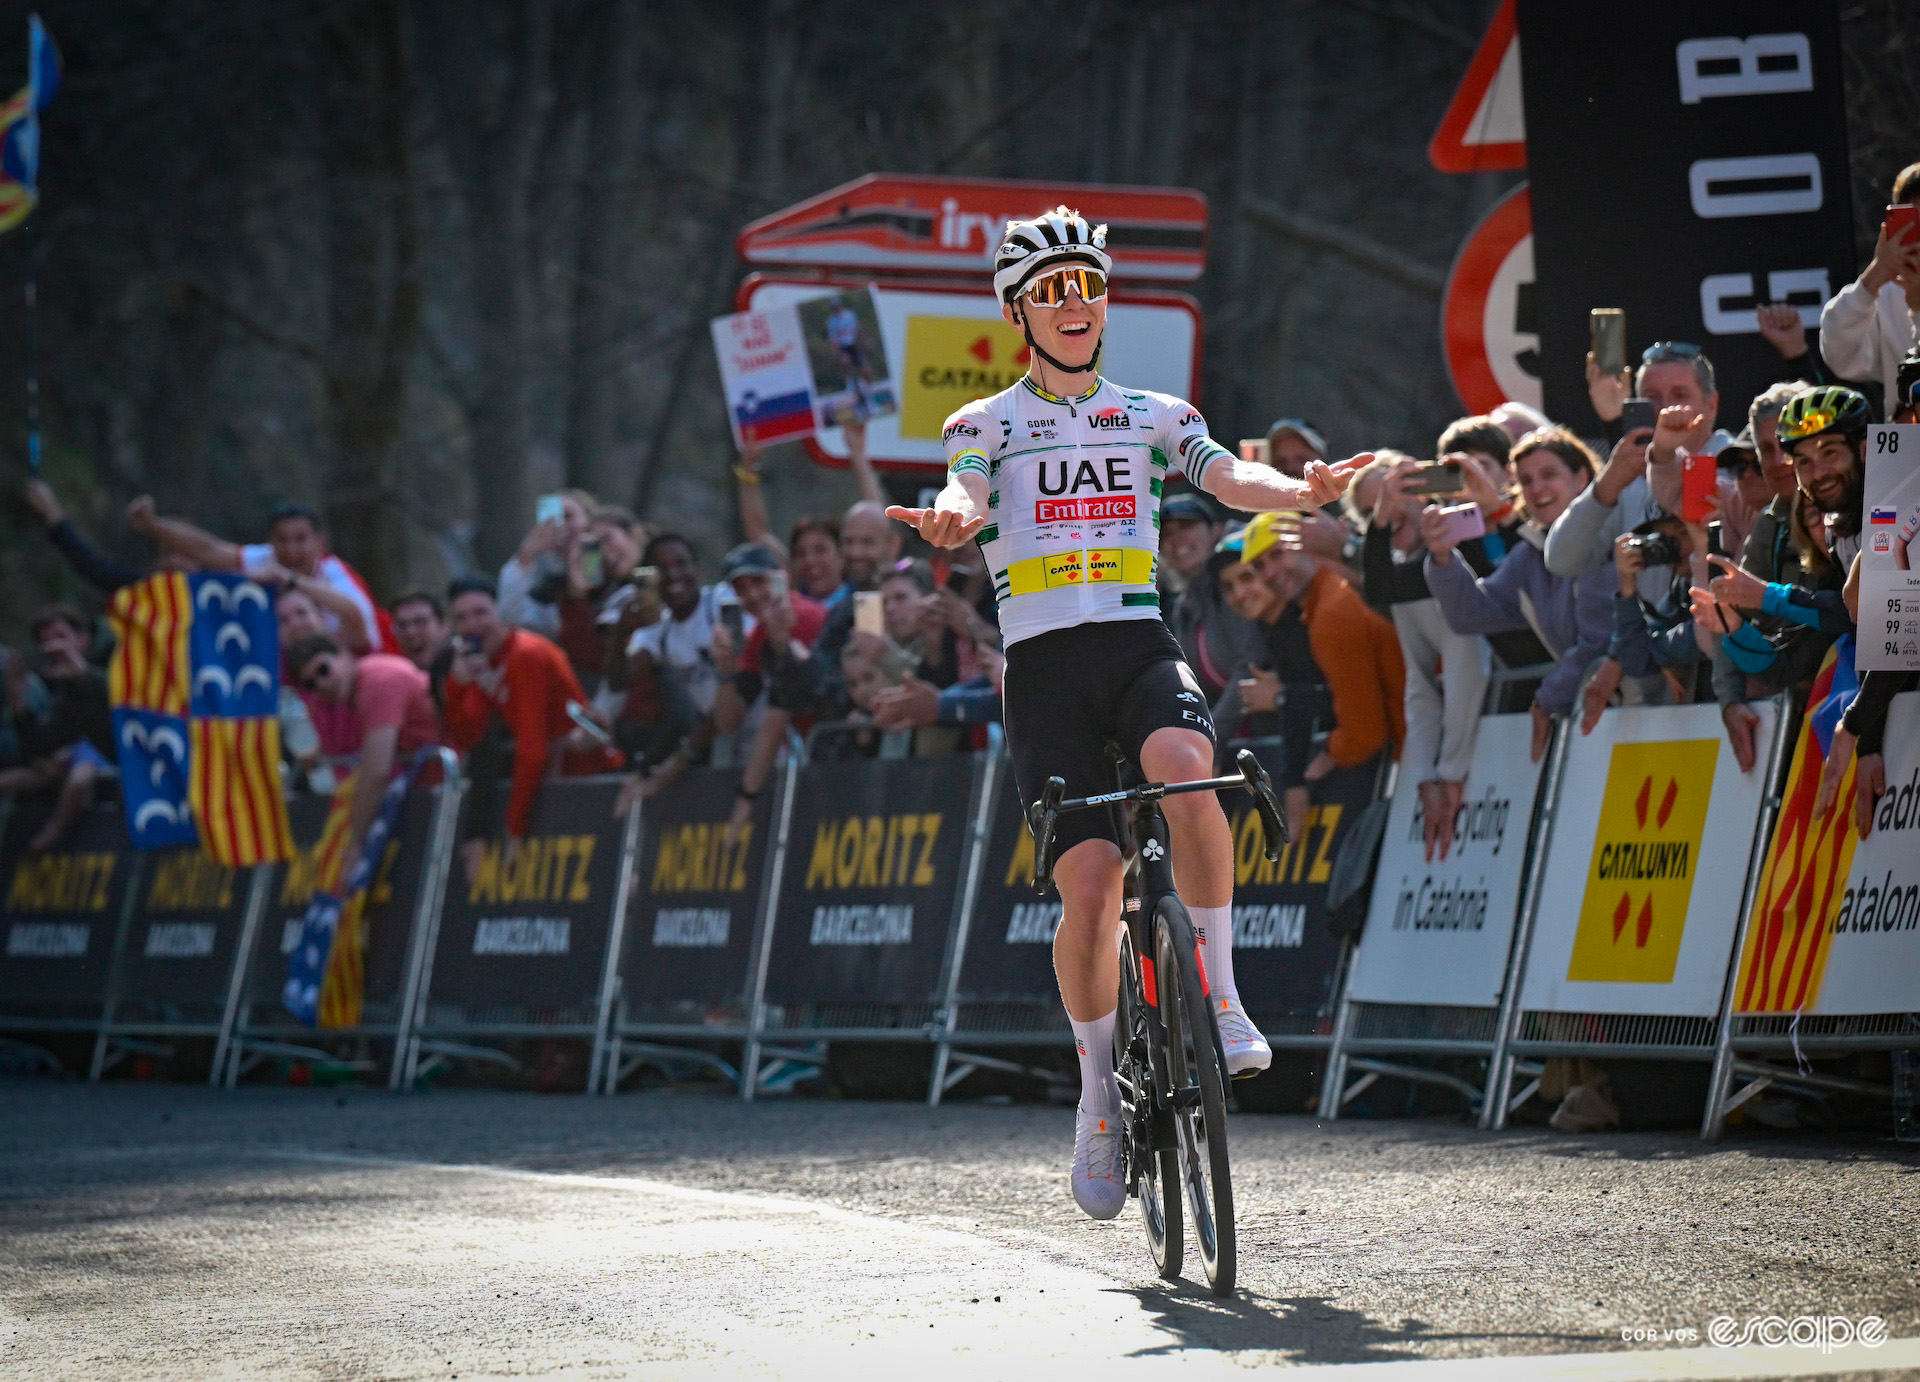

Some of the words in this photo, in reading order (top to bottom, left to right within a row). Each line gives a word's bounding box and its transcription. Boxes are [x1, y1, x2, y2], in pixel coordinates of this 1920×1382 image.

[1027, 418, 1057, 429] GOBIK
[1877, 431, 1899, 454] 98
[1039, 458, 1133, 496] UAE
[1039, 500, 1134, 520] Emirates
[1050, 561, 1118, 575] CATALUNYA
[1887, 599, 1902, 613] 95
[1886, 620, 1900, 635] 99
[1885, 641, 1899, 656] 94
[1141, 786, 1165, 795] wahoo
[806, 813, 944, 890] MORITZ
[1598, 841, 1690, 880] CATALUNYA
[810, 903, 914, 946] BARCELONA
